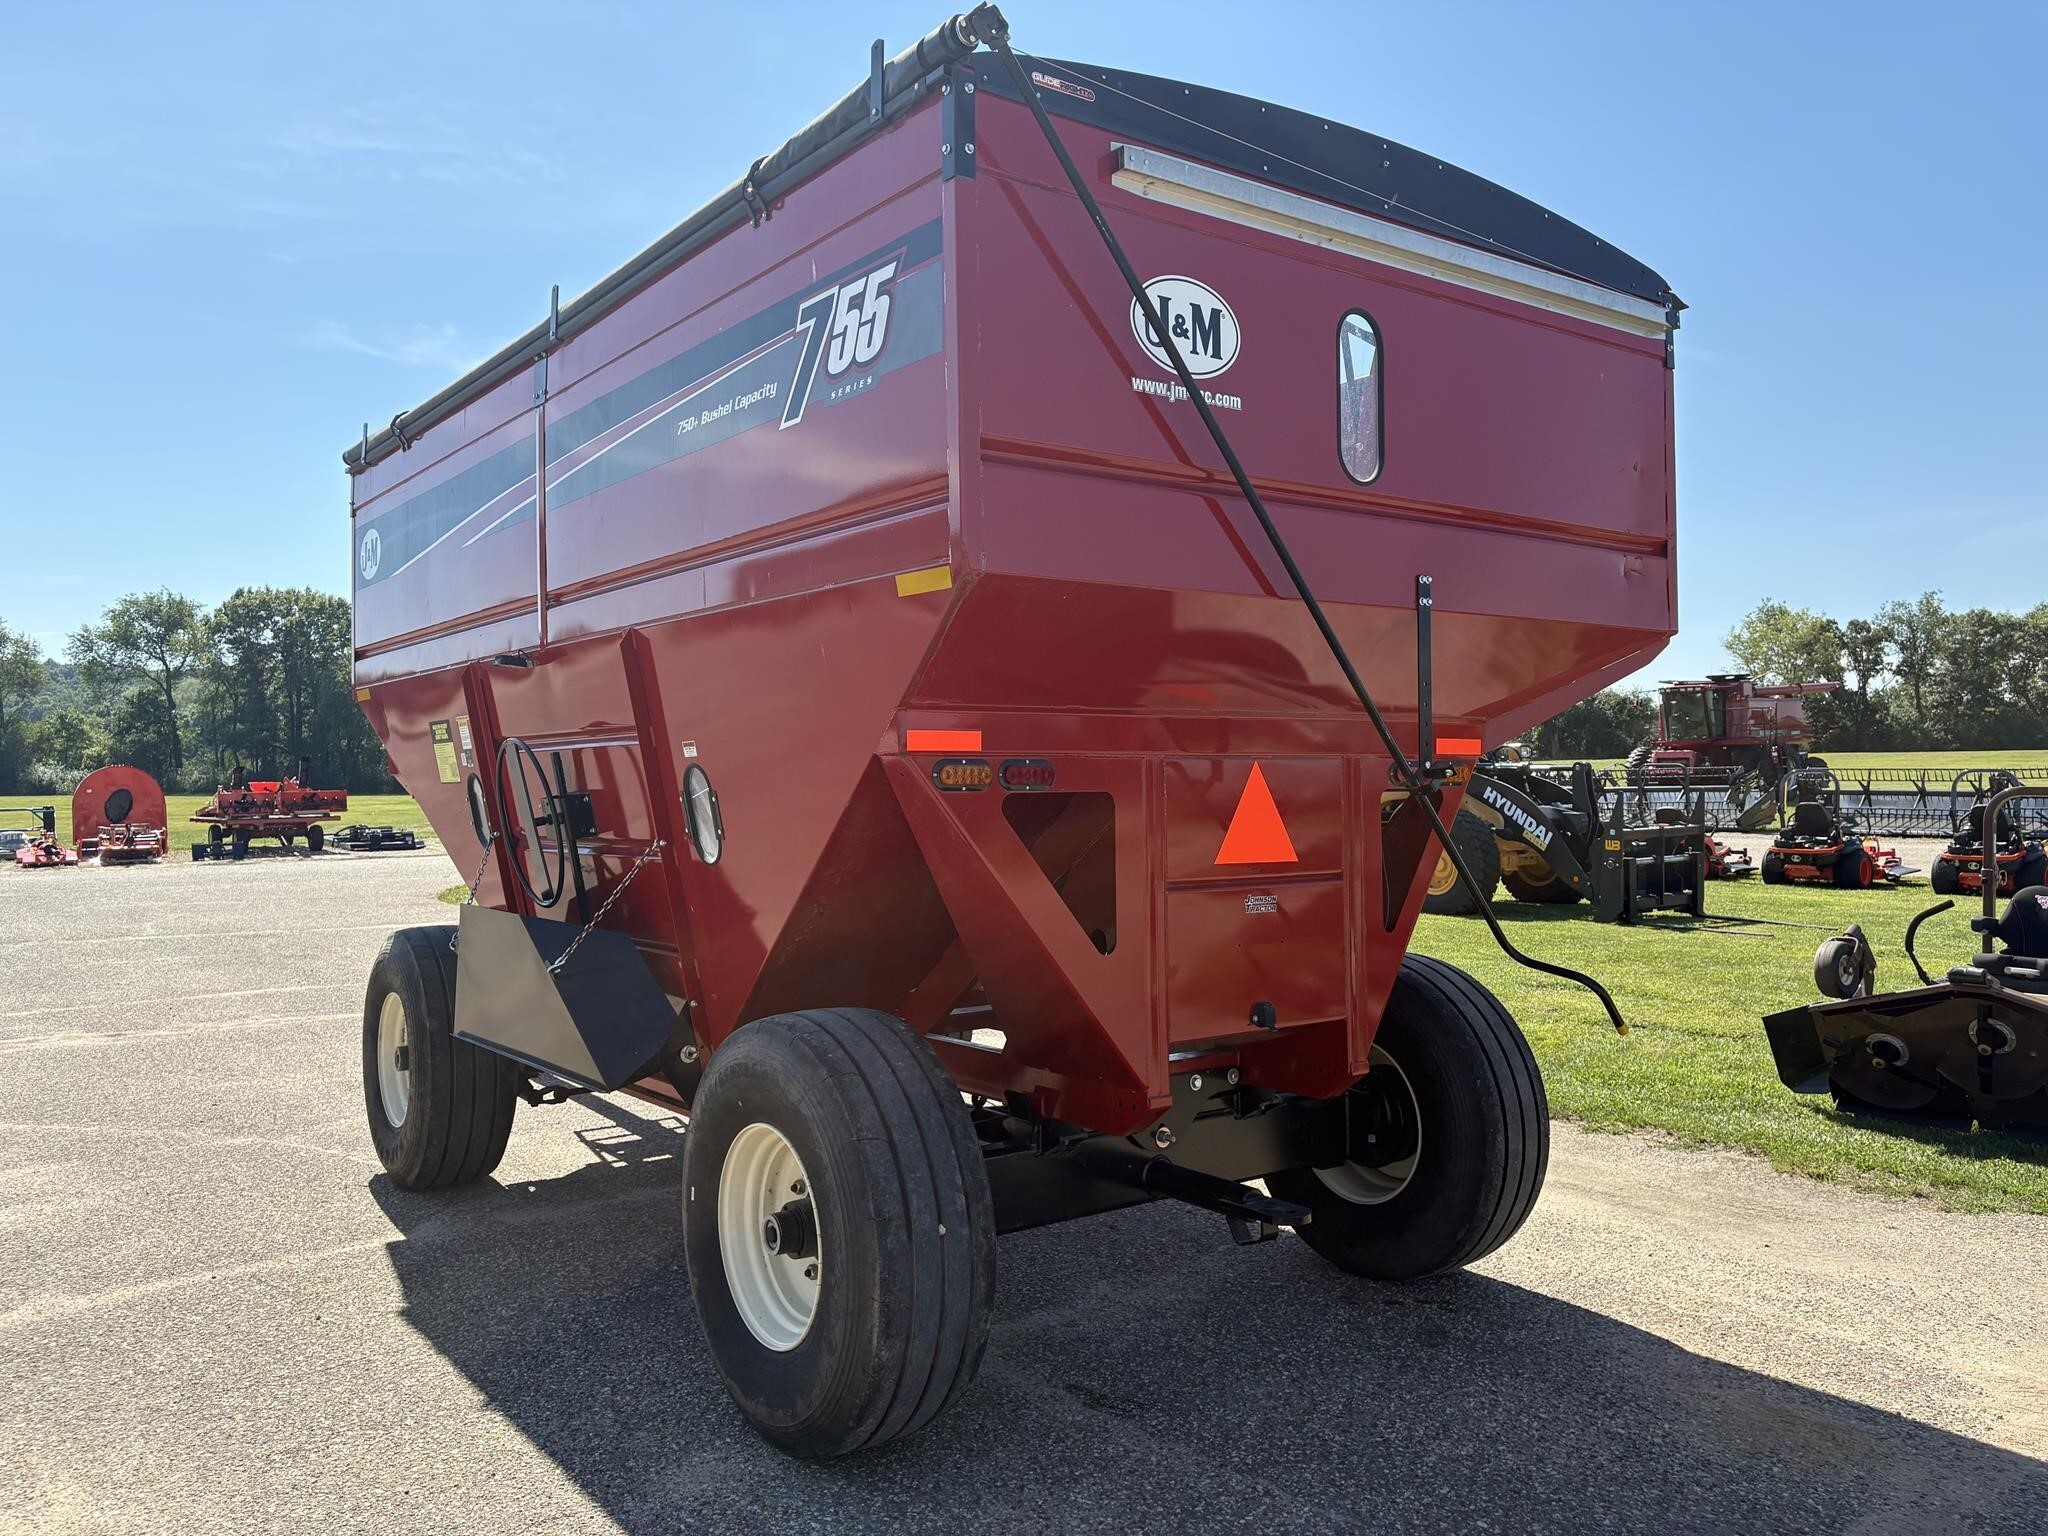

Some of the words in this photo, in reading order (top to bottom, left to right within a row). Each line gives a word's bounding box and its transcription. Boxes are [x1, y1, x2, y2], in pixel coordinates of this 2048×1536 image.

[779, 261, 897, 430] 755
[1142, 295, 1223, 360] J&M
[677, 417, 699, 436] 750+
[701, 399, 733, 426] Bushel
[734, 382, 778, 410] Capacity
[830, 376, 873, 400] SERIES
[1131, 377, 1242, 410] www.jmc.com
[1482, 786, 1554, 844] HYUNDAI
[1244, 895, 1278, 904] JOHNSON
[1245, 903, 1277, 913] TRACTOR
